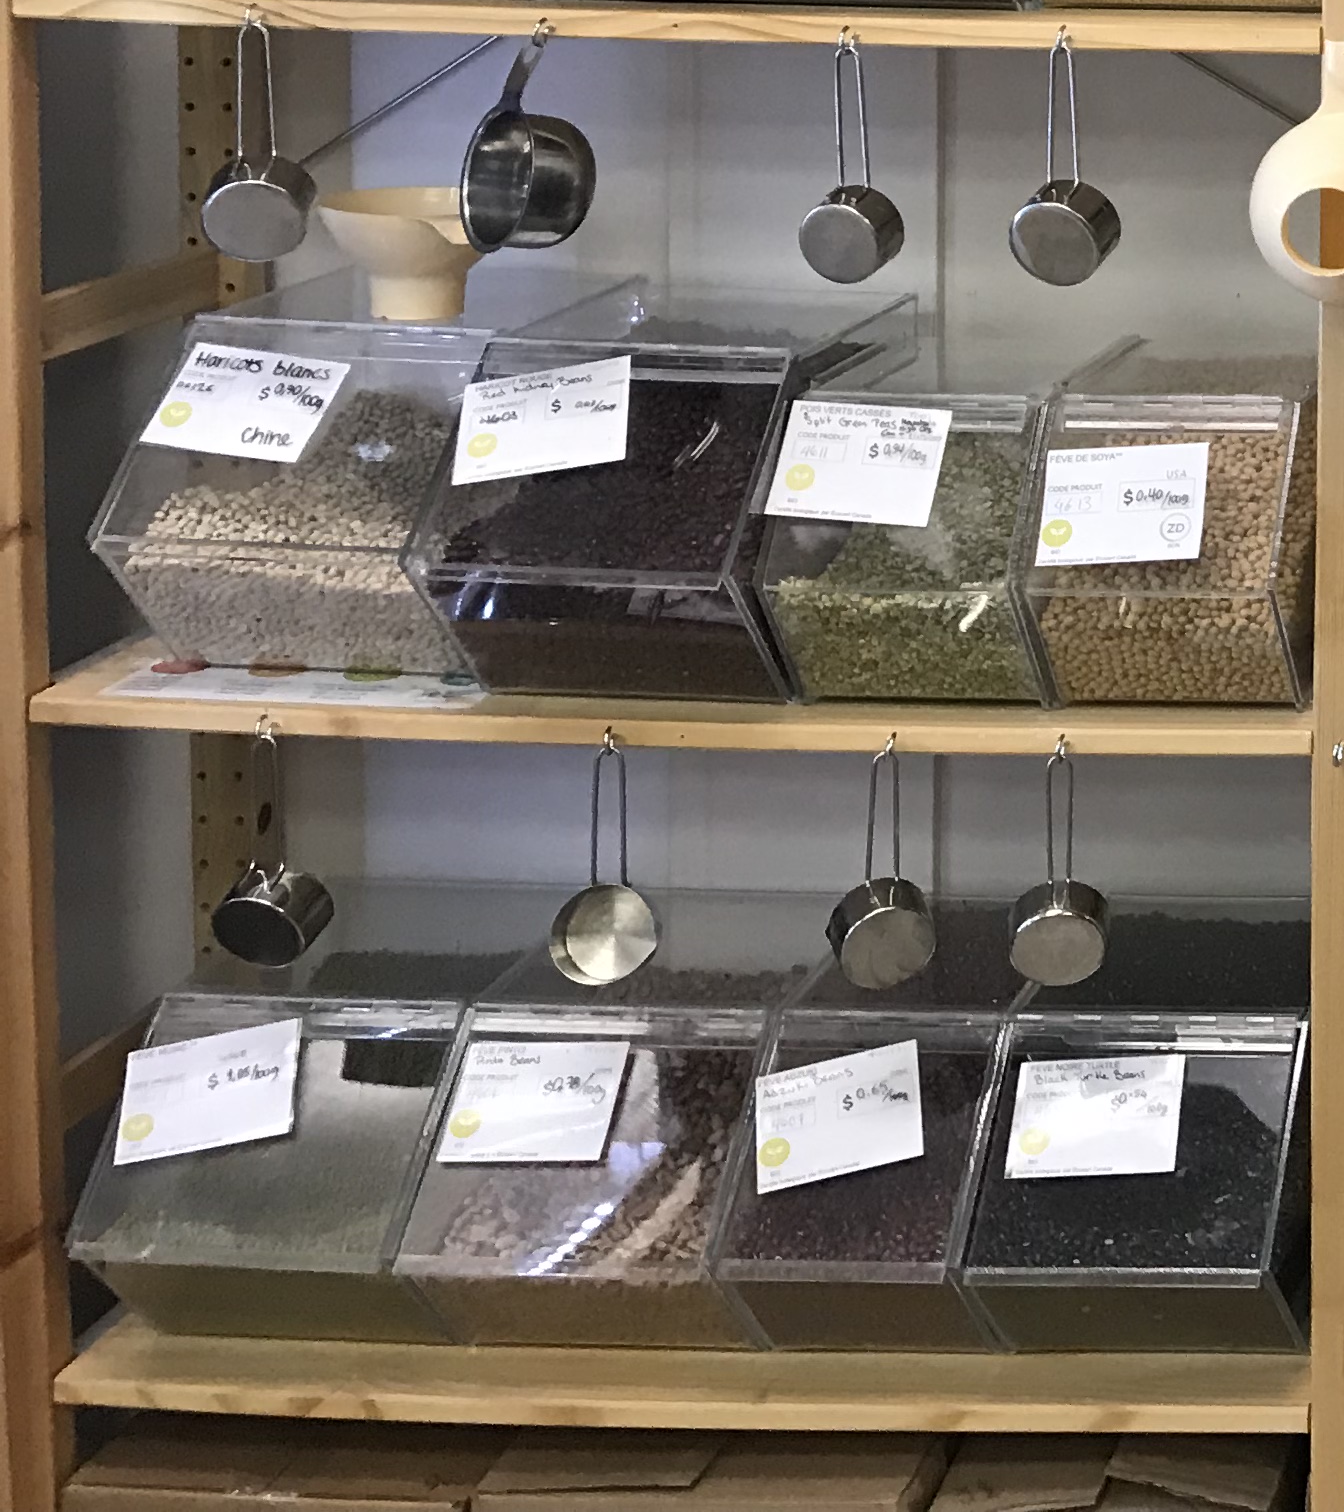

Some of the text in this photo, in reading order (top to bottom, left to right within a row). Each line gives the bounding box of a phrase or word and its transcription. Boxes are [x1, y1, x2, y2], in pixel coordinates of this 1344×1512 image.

[194, 351, 331, 381] Haricots blancs
[823, 405, 853, 415] VERTS
[240, 425, 294, 447] Chine
[797, 431, 818, 439] CODE
[1076, 453, 1088, 462] DE
[1091, 452, 1116, 462] SOYA
[1166, 469, 1187, 479] USA
[1047, 483, 1103, 493] CODE PRODUIT
[1166, 522, 1185, 534] ZD
